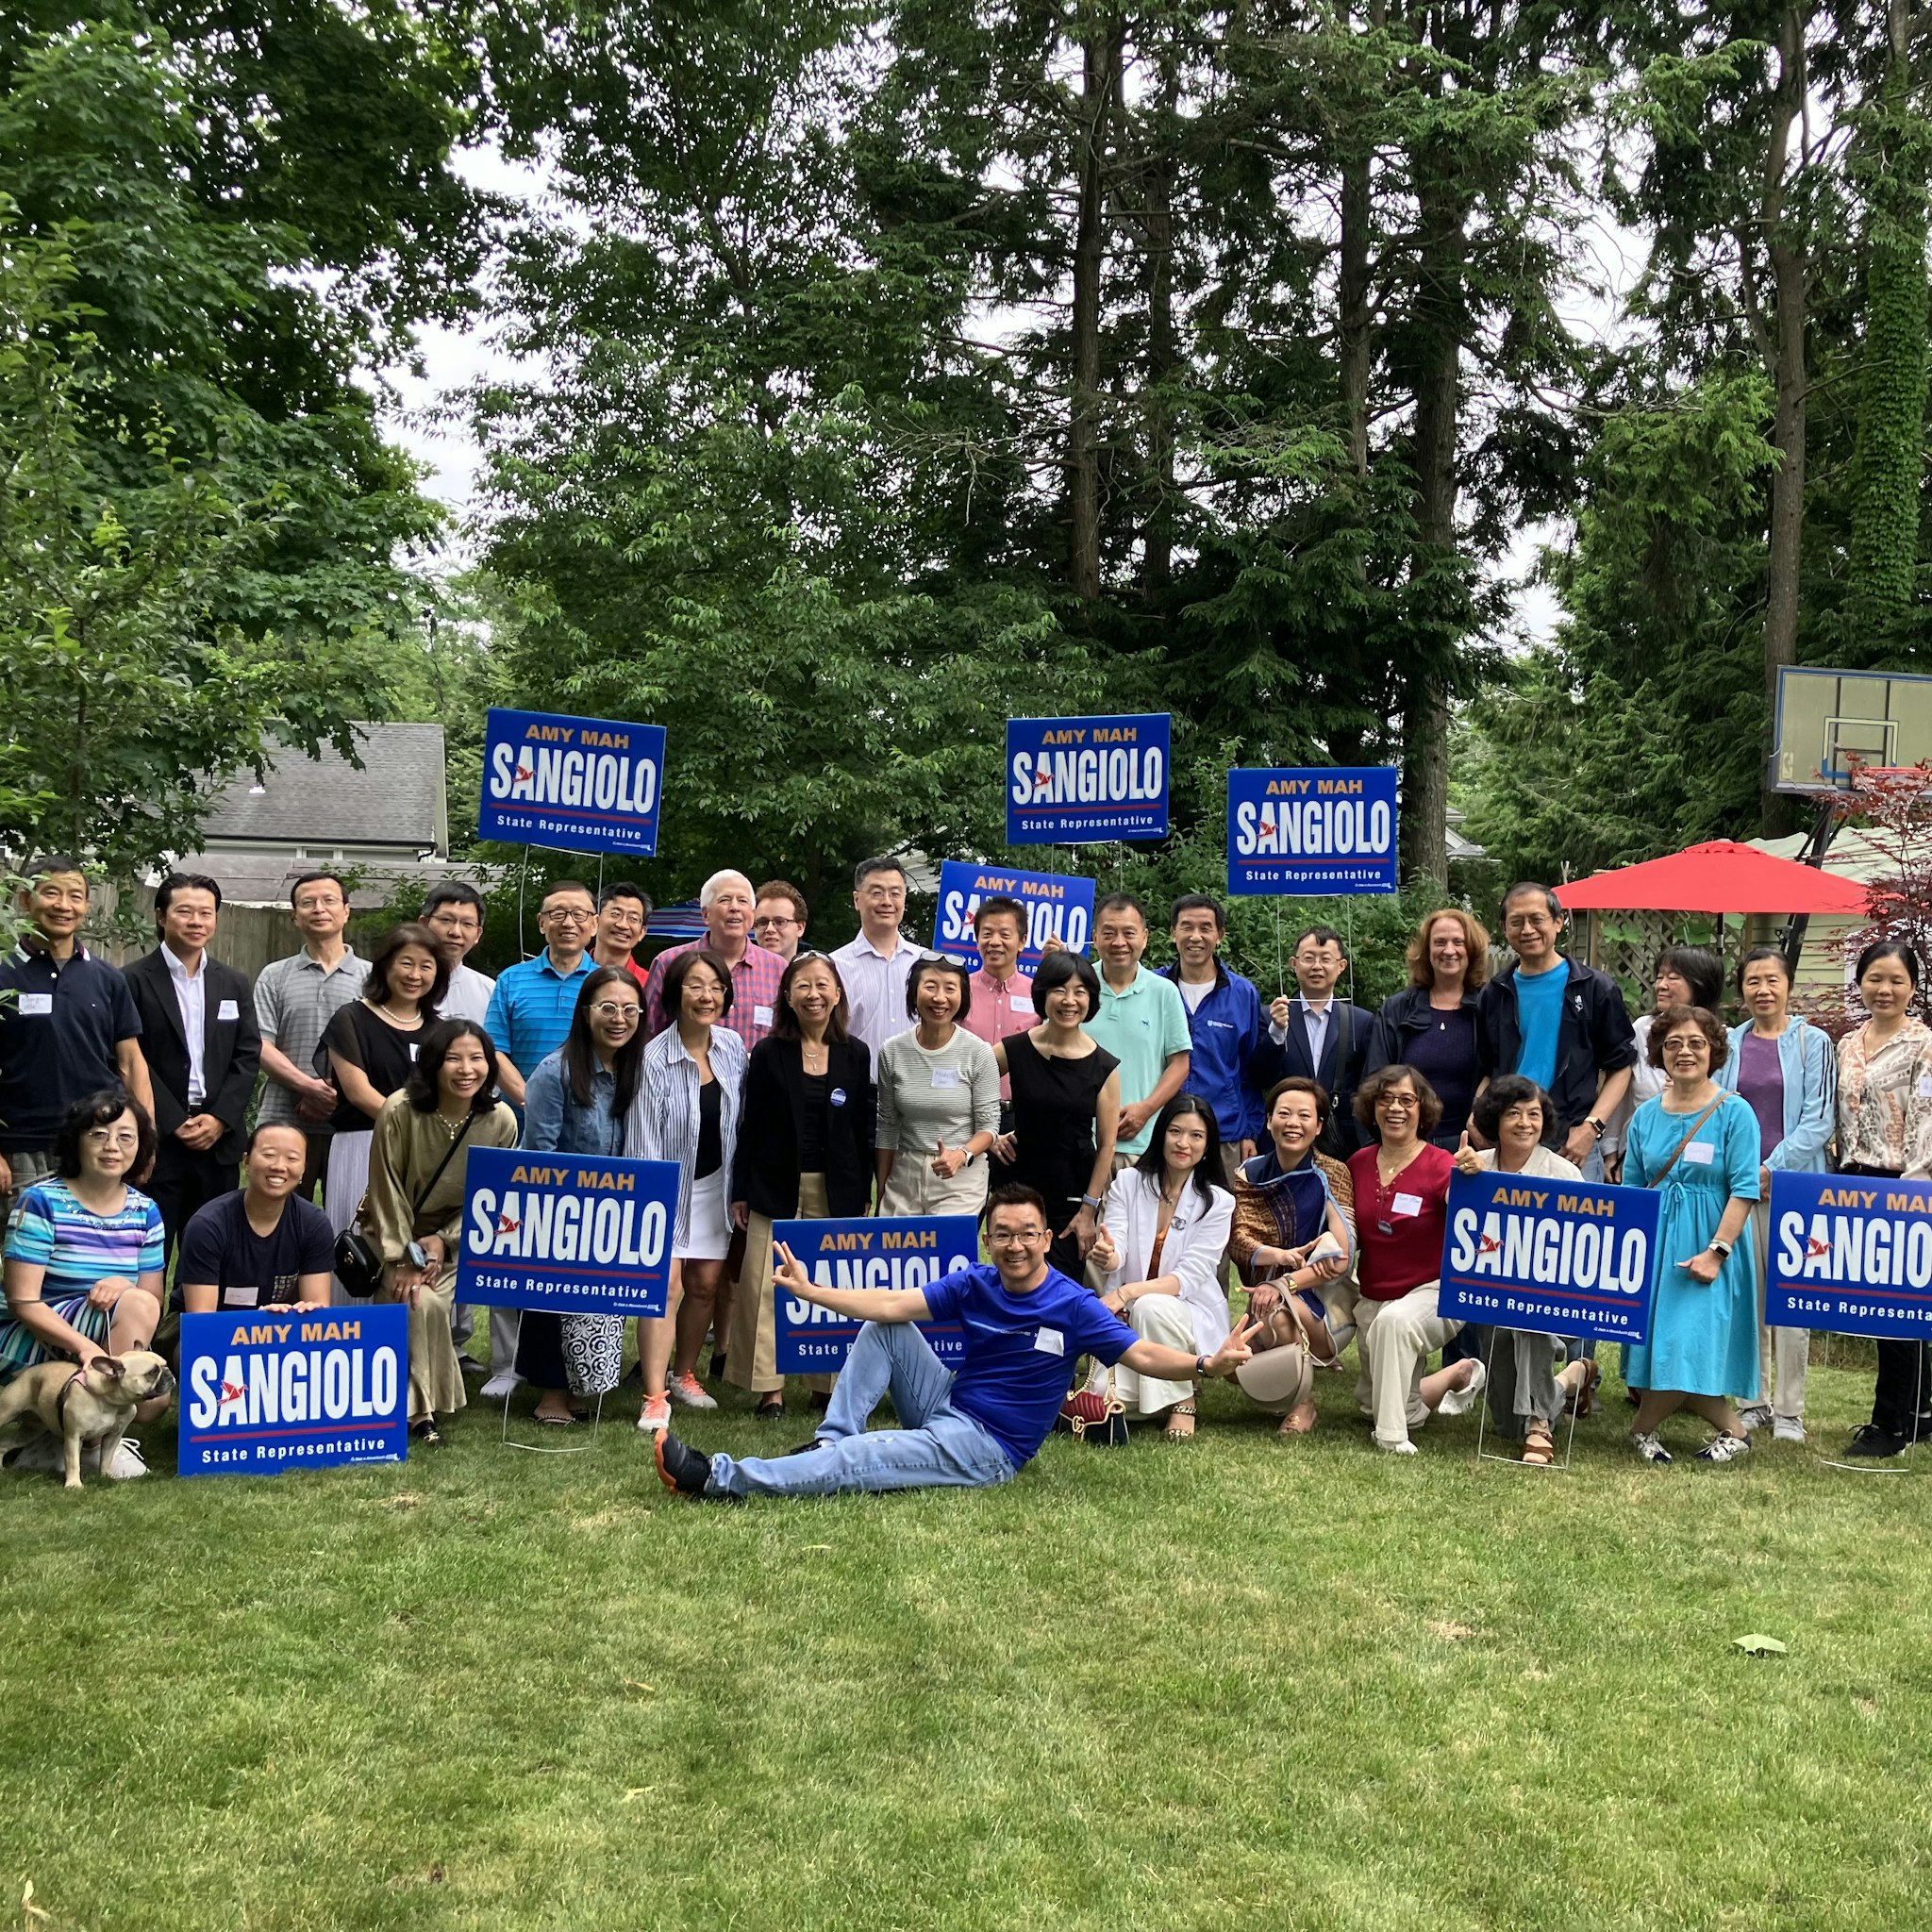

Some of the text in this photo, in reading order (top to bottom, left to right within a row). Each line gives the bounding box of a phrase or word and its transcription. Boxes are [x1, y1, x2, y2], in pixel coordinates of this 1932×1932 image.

[525, 724, 629, 749] AMY MAH
[1041, 727, 1137, 744] AMY MAH
[490, 742, 657, 814] SANGIOLO
[1012, 746, 1162, 805] SANGIOLO
[1266, 779, 1363, 795] AMY MAH
[497, 815, 641, 839] State Representative
[1022, 815, 1153, 830] State Representative
[1237, 800, 1391, 855] SANGIOLO
[974, 875, 1064, 899] AMY MAH
[1246, 869, 1381, 881] State Representative
[942, 891, 1088, 954] SAIOLO
[510, 1166, 635, 1191] AMY MAH
[1491, 1187, 1615, 1218] AMY MAH
[1818, 1188, 1932, 1213] AMY MA
[468, 1188, 667, 1267] SANGIOLO
[819, 1230, 937, 1252] AMY MAH
[1451, 1208, 1647, 1294] SANGIOLO
[475, 1274, 648, 1299] State Representative
[1458, 1291, 1628, 1325] State Representative
[1788, 1297, 1831, 1312] State
[230, 1321, 361, 1346] AMY MAH
[798, 1343, 839, 1356] State
[190, 1346, 398, 1429] SANGIOLO
[202, 1448, 248, 1463] State
[257, 1438, 385, 1460] Representative
